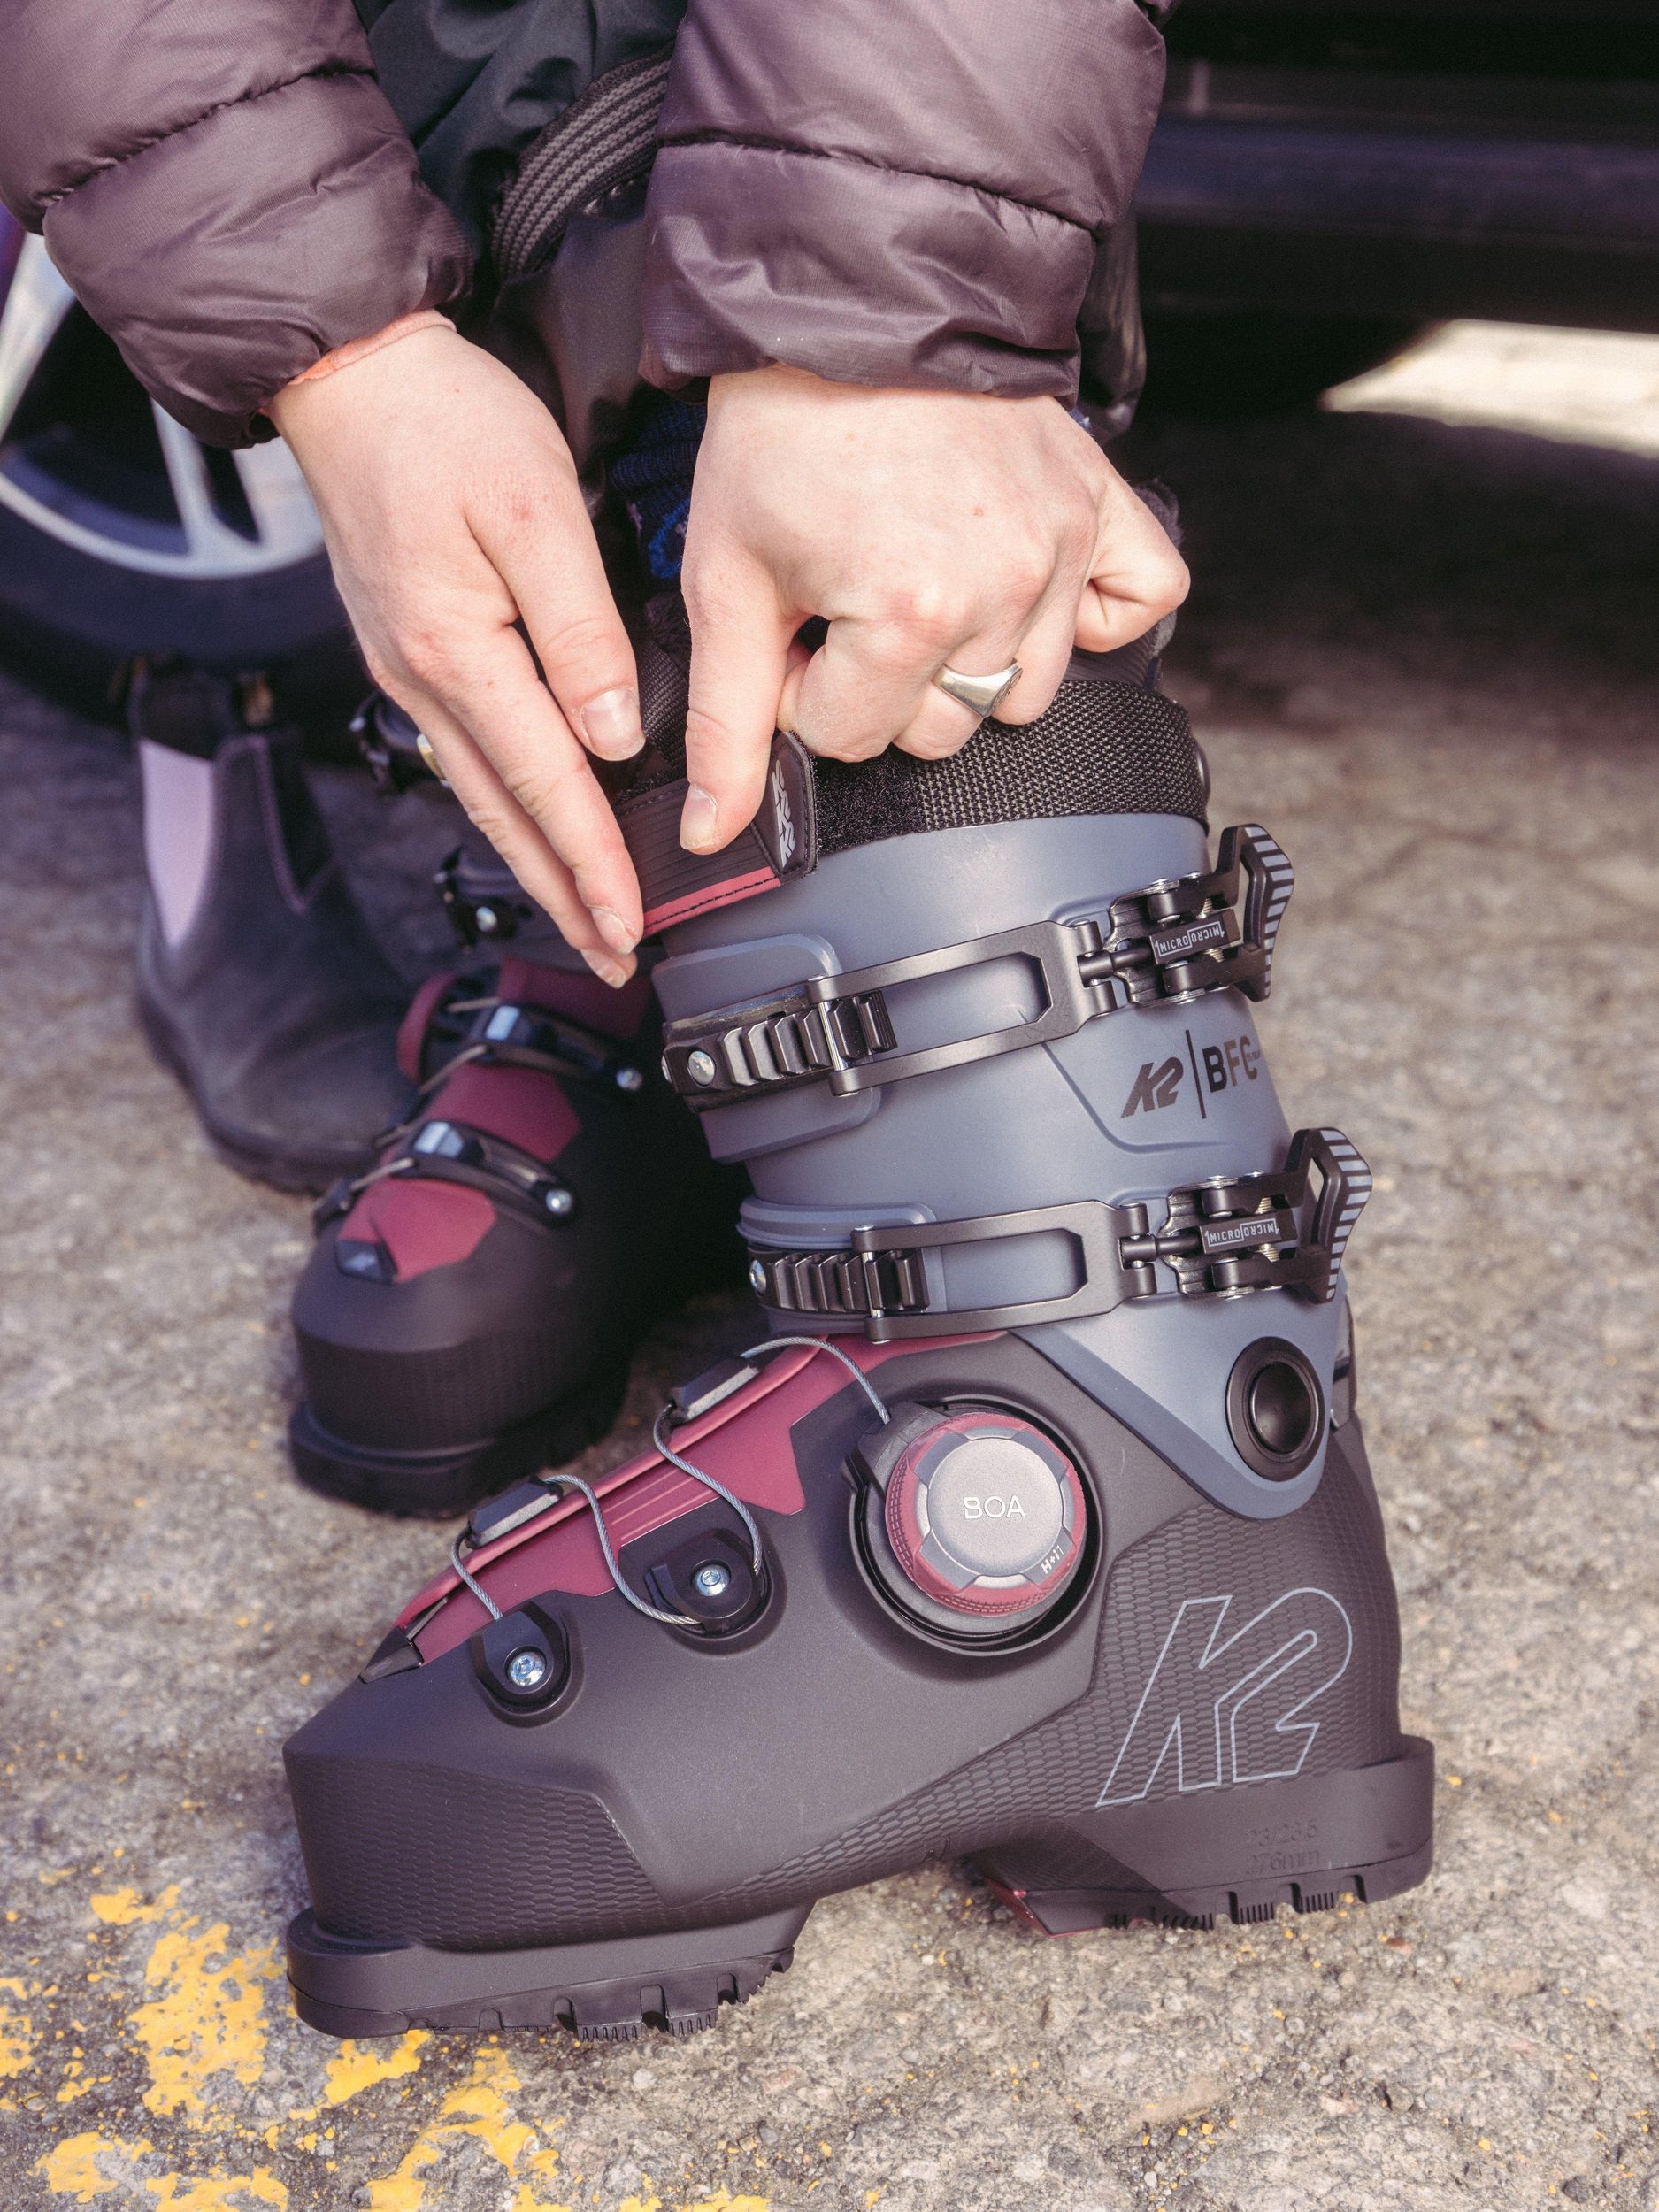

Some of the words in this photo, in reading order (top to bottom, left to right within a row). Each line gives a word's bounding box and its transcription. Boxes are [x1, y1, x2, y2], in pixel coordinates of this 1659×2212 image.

[1158, 936, 1189, 951] MICRO
[1202, 1034, 1258, 1093] BFC
[1119, 1056, 1184, 1119] K2
[1210, 1228, 1241, 1243] MICRO
[964, 1495, 1026, 1519] BOA
[1095, 1586, 1353, 1808] K2
